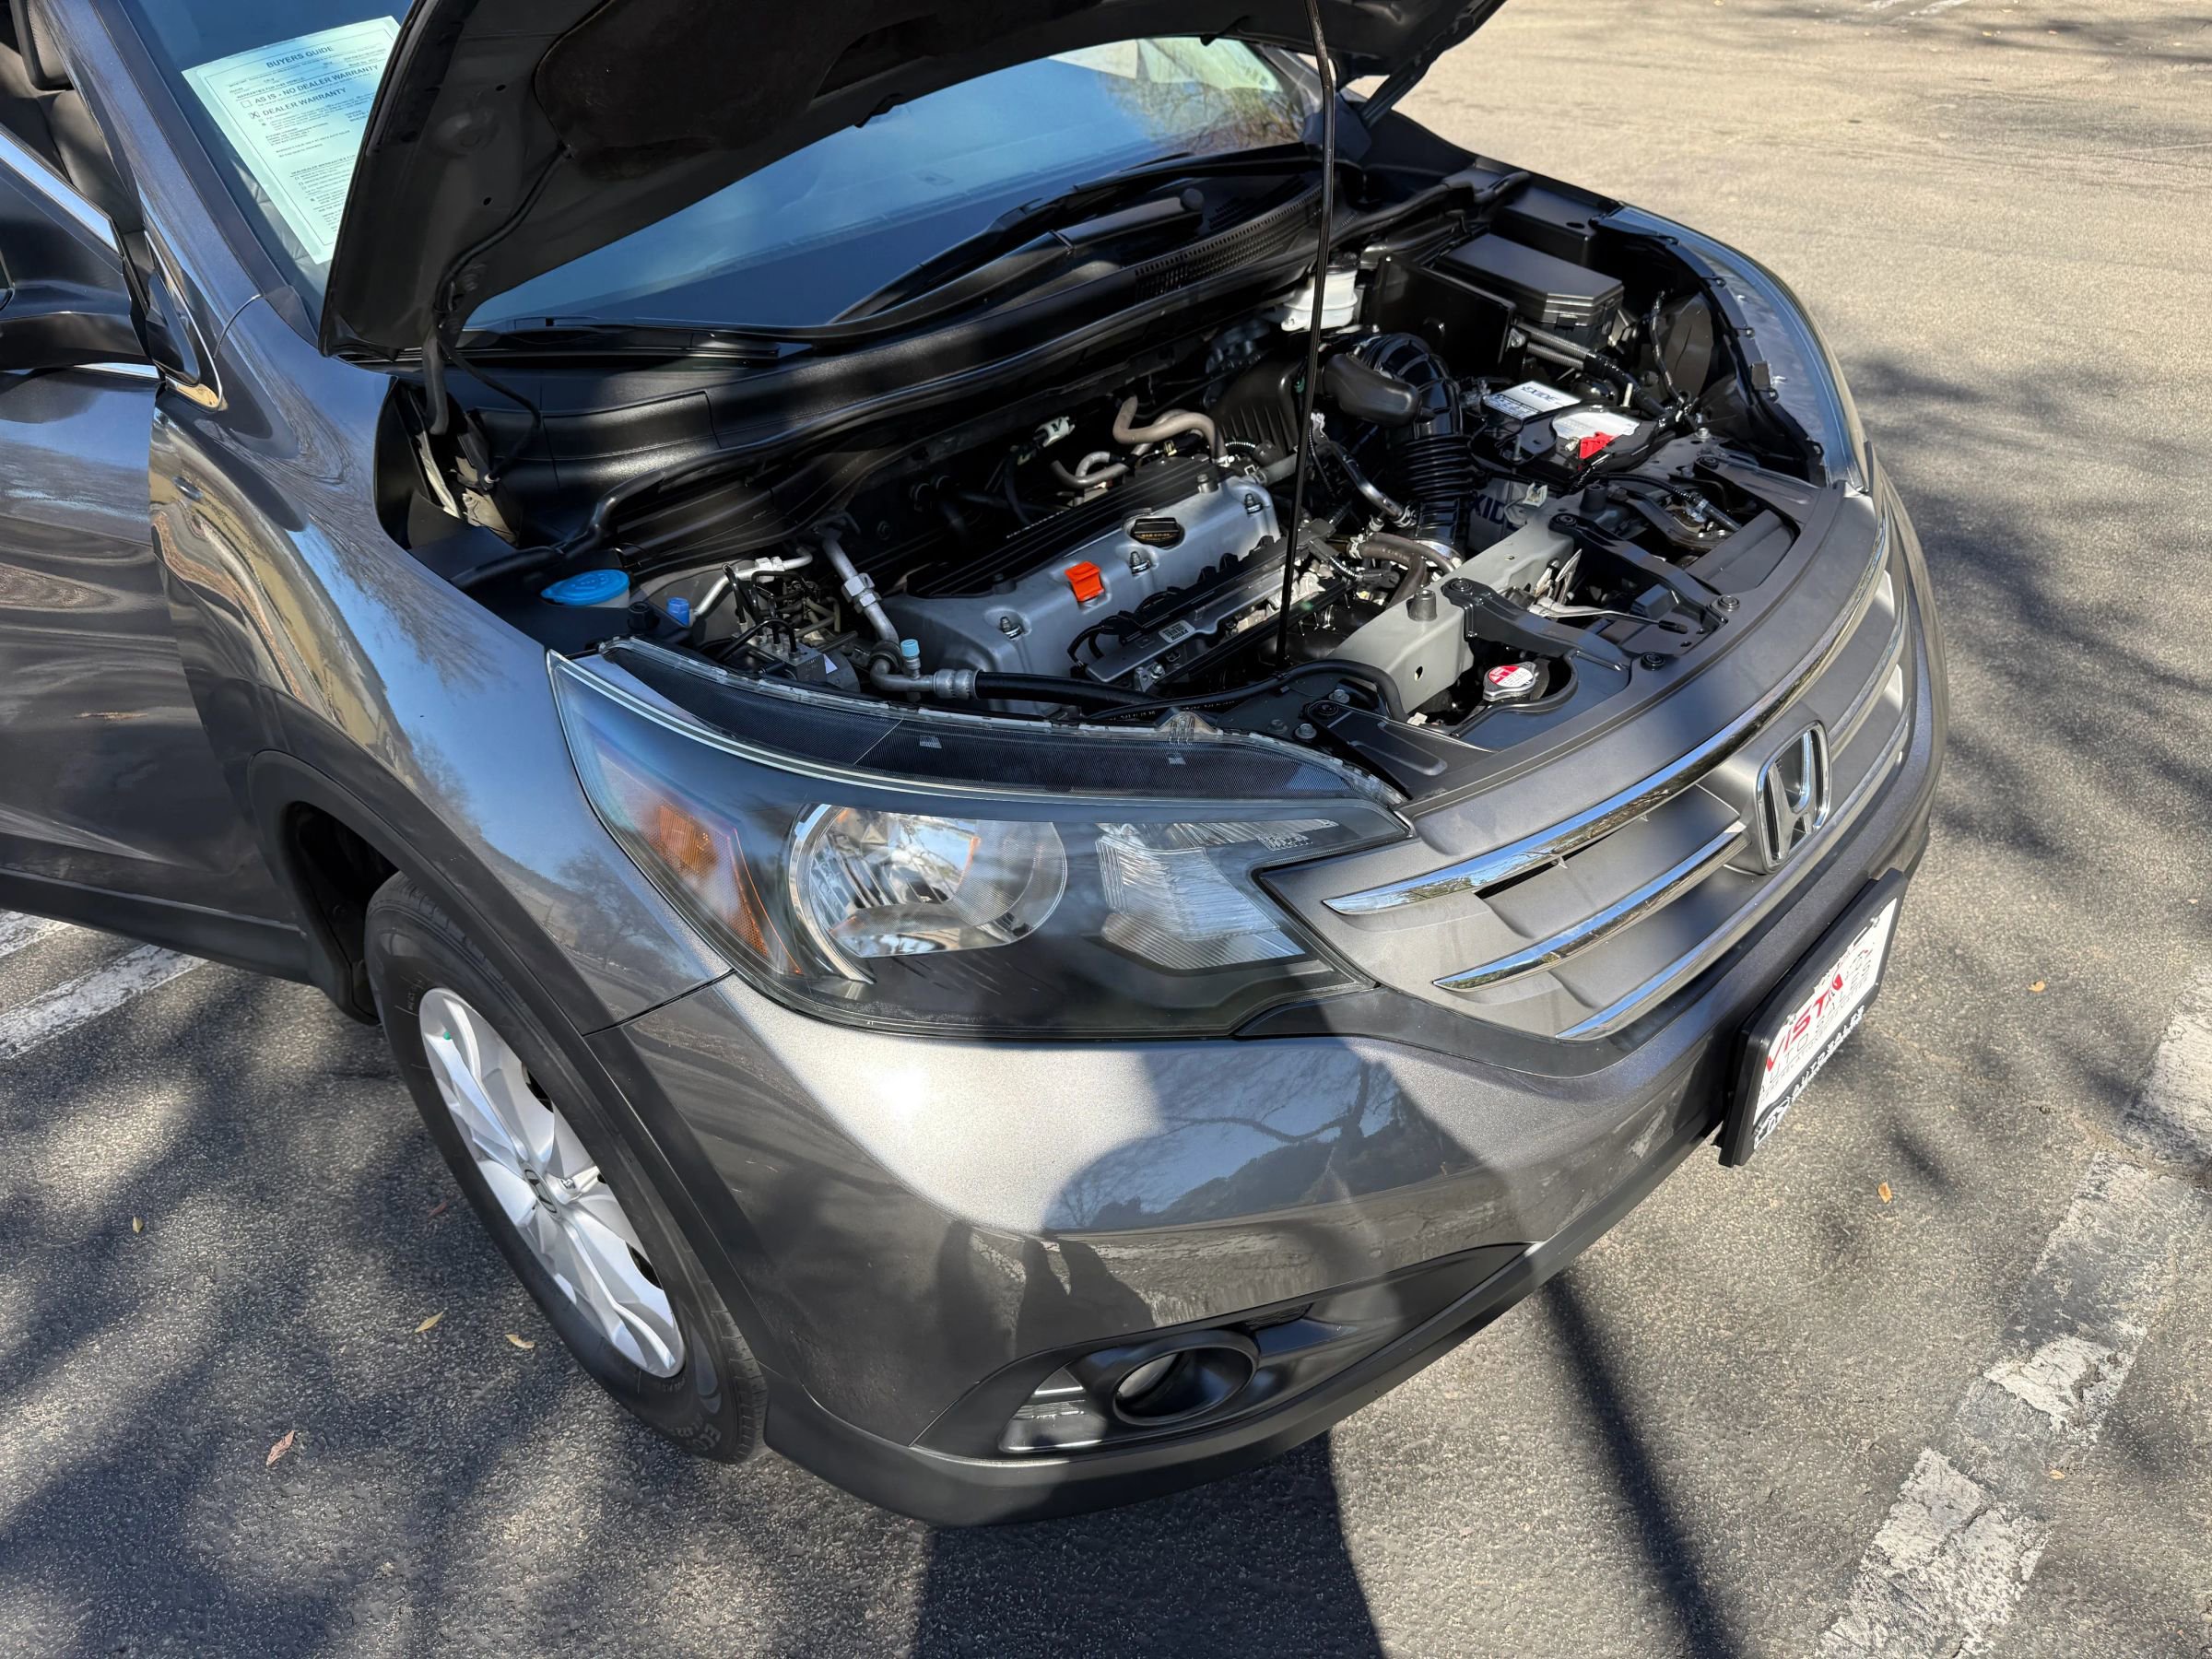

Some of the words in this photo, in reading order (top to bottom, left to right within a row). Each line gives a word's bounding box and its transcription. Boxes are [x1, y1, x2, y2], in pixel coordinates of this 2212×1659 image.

[266, 53, 304, 68] BUYERS
[306, 45, 334, 58] GUIDE
[282, 88, 296, 96] NO
[297, 76, 332, 91] DEALER
[332, 65, 379, 81] WARRANTY
[263, 101, 299, 117] DEALER
[300, 87, 347, 106] WARRANTY
